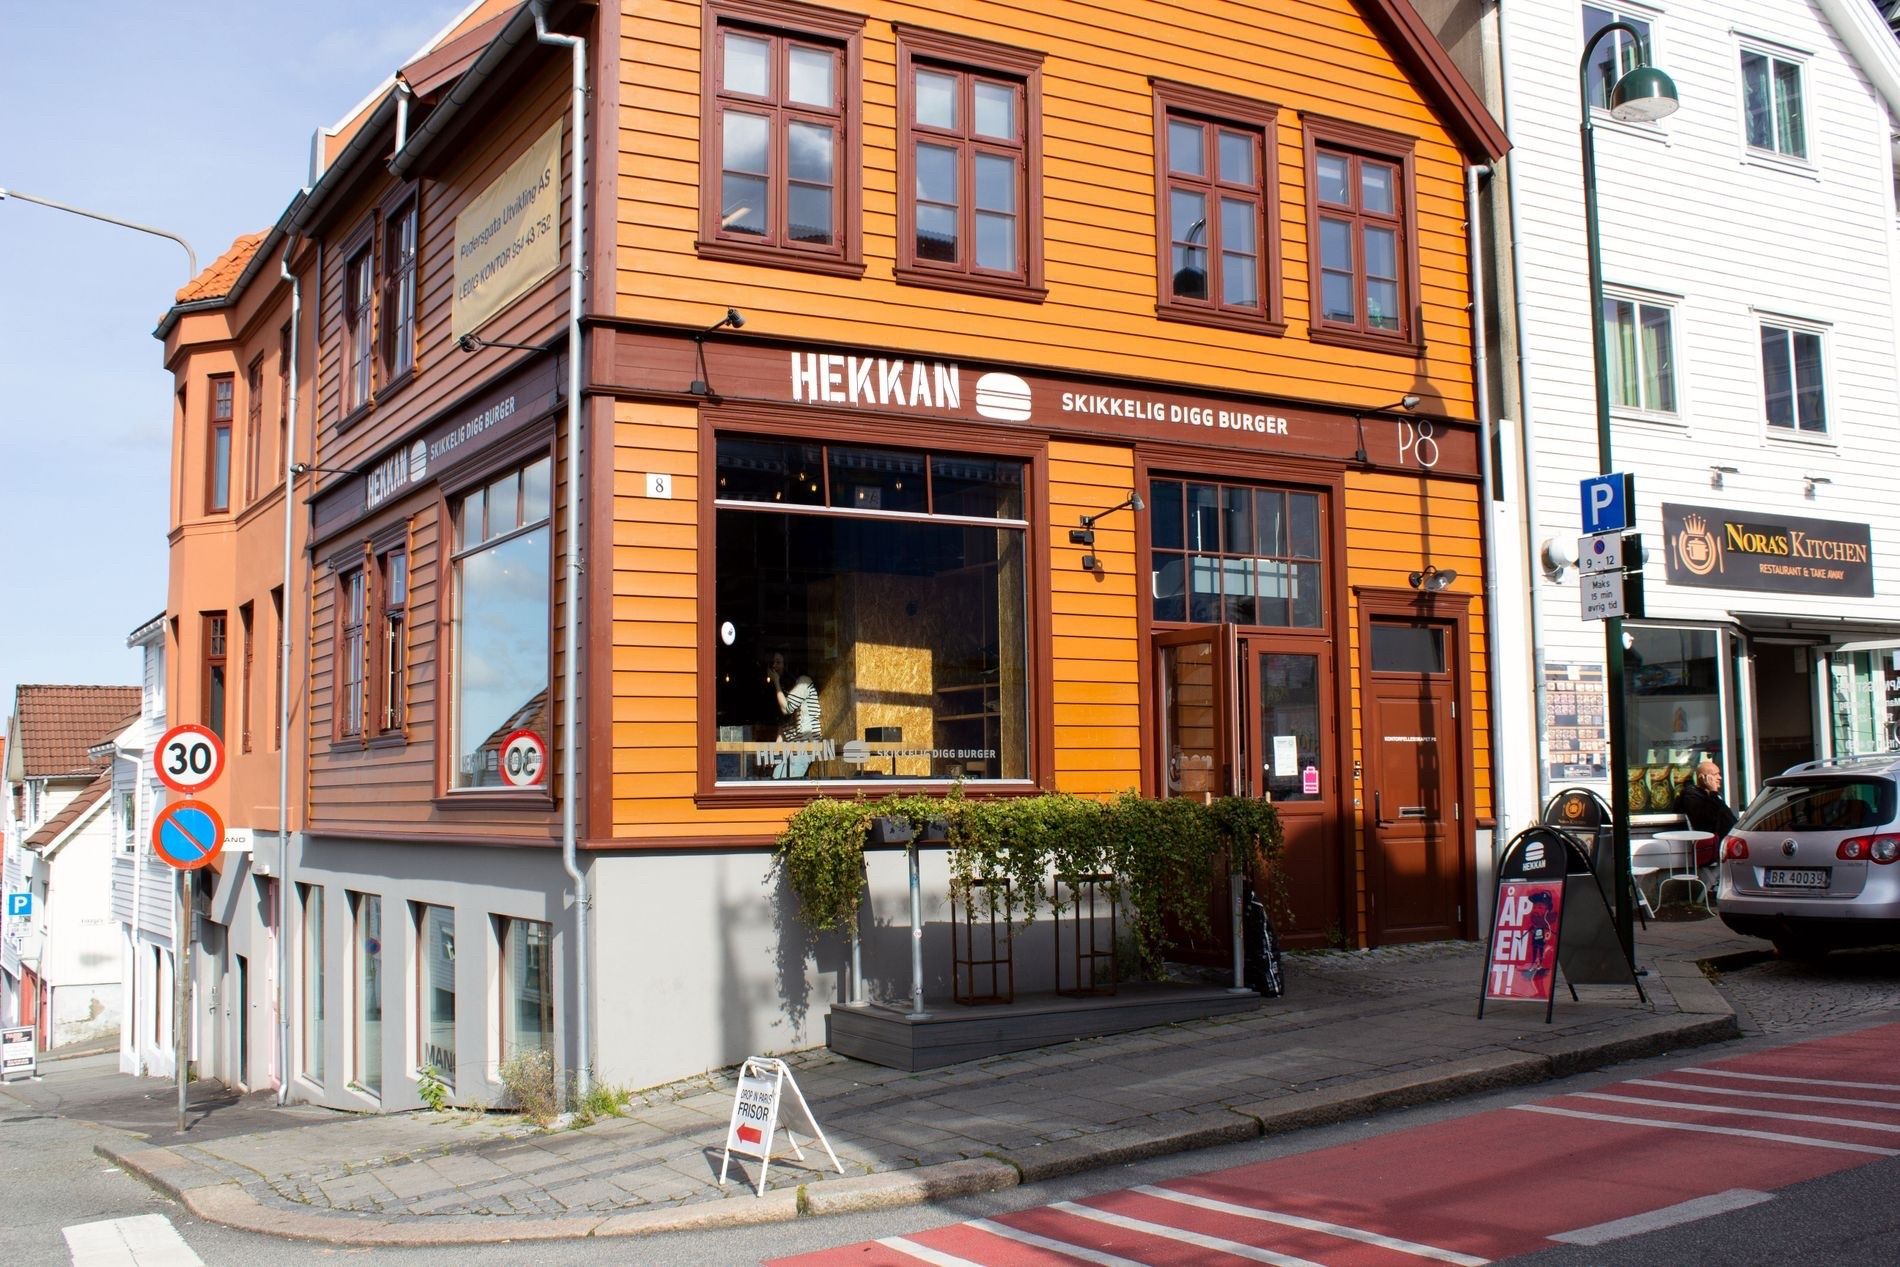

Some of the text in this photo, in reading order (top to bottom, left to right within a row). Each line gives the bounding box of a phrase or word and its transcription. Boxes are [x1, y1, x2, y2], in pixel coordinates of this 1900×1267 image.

[460, 168, 551, 260] Pedersgata Utvikling AS
[458, 213, 552, 301] LEDIG KONTOR 954 43 752
[789, 350, 962, 411] HEKKAN
[430, 396, 516, 461] SKIKKELIG DIGG BURGER
[1061, 392, 1289, 436] SKIKKELIG DIGG BURGER
[1397, 417, 1440, 468] P8
[367, 445, 408, 511] HEKKAN
[655, 477, 665, 494] 8
[1590, 482, 1614, 526] P
[1586, 557, 1593, 569] 9
[1605, 554, 1615, 566] 12
[1790, 531, 1869, 564] KITCHEN
[1592, 579, 1611, 590] Maks
[1759, 563, 1845, 580] RESTAURANT & TAKE AWAY
[1591, 589, 1613, 601] 15 min
[1608, 600, 1618, 610] tid
[168, 742, 212, 775] 30
[876, 749, 931, 759] SKIKKELIG
[932, 749, 956, 760] DIGG
[957, 749, 997, 760] BURGER
[1522, 858, 1547, 872] HEKKAN
[1771, 871, 1785, 883] BR
[14, 895, 28, 914] P
[1498, 885, 1534, 927] ÅP
[1495, 929, 1530, 961] EN
[1492, 963, 1515, 995] T!
[425, 1042, 456, 1075] MAN
[737, 1101, 770, 1122] FRISØR
[740, 1088, 774, 1104] DROP IN PARIS
